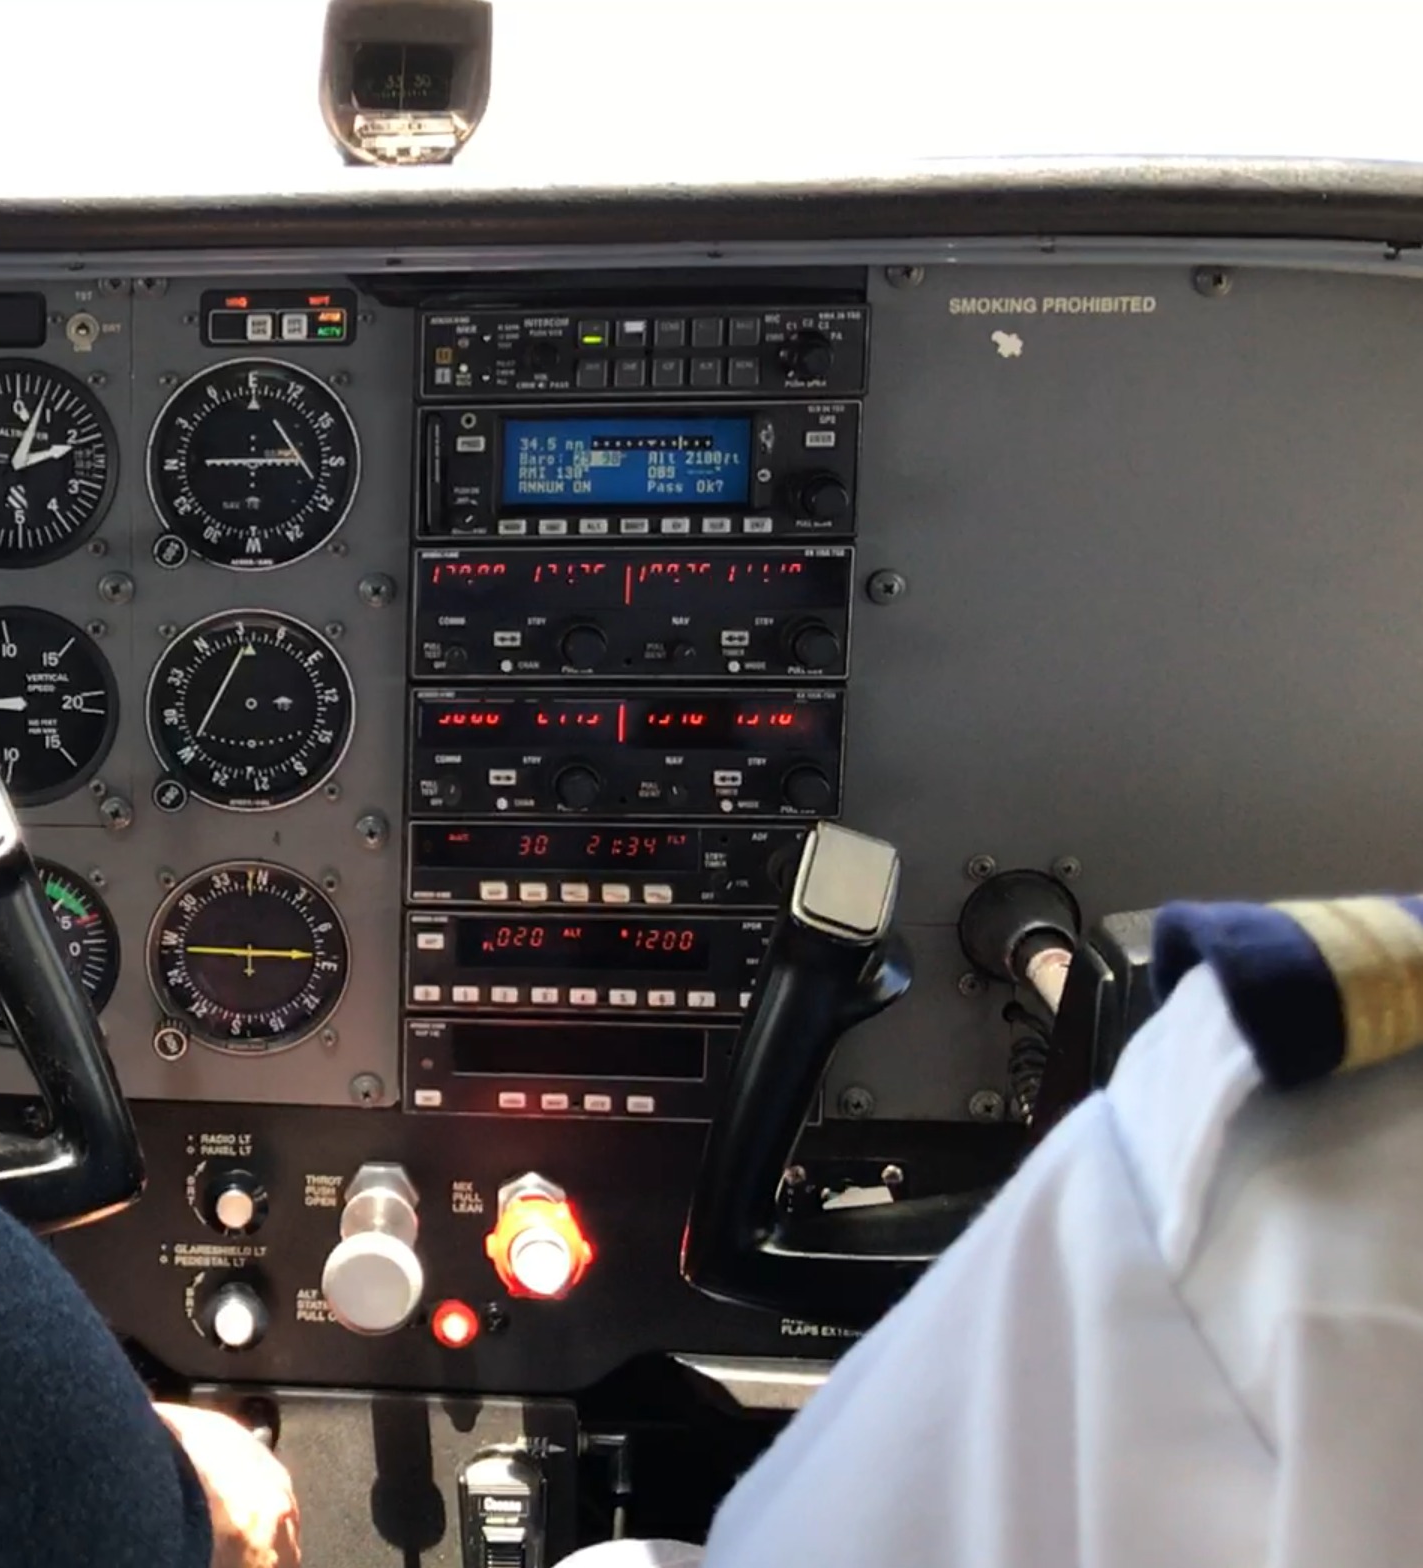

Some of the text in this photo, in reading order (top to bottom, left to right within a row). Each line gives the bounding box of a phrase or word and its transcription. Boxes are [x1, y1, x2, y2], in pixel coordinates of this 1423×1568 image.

[949, 296, 1156, 314] SMOKING PROHIBITED
[524, 318, 569, 327] INTERCOM
[786, 322, 798, 331] C1
[803, 319, 814, 327] C2
[317, 327, 342, 336] ACTV
[248, 371, 259, 387] E
[206, 385, 218, 399] 6
[287, 381, 305, 398] 12
[13, 400, 25, 414] 0
[45, 408, 51, 423] 1
[319, 412, 335, 429] 15
[176, 417, 190, 429] 3
[67, 429, 77, 445] 2
[520, 437, 557, 451] 34.5
[163, 459, 179, 471] N
[328, 456, 346, 468] S
[519, 452, 564, 466] Baro:
[648, 451, 676, 465] Alt
[519, 467, 546, 480] RMI
[68, 479, 79, 494] 3
[573, 481, 592, 493] ON
[647, 480, 724, 493] Pass Ok?
[47, 497, 59, 510] 4
[173, 496, 191, 515] 33
[318, 495, 335, 512] 21
[15, 510, 25, 524] 5
[203, 526, 222, 543] 30
[285, 524, 304, 542] 24
[245, 538, 262, 553] W
[527, 617, 547, 625] STBY
[671, 617, 690, 625] NAV
[235, 621, 245, 636] 3
[276, 626, 287, 640] 6
[2, 643, 17, 658] 10
[193, 636, 210, 653] N
[42, 652, 59, 666] 15
[306, 649, 324, 666] E
[517, 661, 540, 669] CHAN
[26, 673, 69, 682] VERTICAL
[167, 668, 184, 686] 33
[27, 684, 56, 692] SPEED
[62, 695, 84, 709] 20
[324, 688, 339, 703] 12
[163, 709, 178, 725] 30
[45, 735, 60, 749] 15
[318, 729, 333, 744] 15
[4, 747, 20, 762] 10
[177, 747, 196, 765] W
[435, 755, 462, 764] COMM
[665, 756, 684, 765] NAV
[748, 757, 767, 766] STBY
[292, 761, 308, 777] S
[211, 771, 229, 787] 24
[254, 777, 270, 791] 21
[752, 833, 768, 841] ADF
[212, 873, 231, 888] 33
[256, 869, 269, 885] N
[295, 887, 307, 901] 3
[179, 893, 197, 912] 30
[319, 922, 332, 933] 6
[563, 928, 582, 938] ALT
[161, 930, 178, 946] W
[497, 927, 544, 947] 020
[635, 930, 694, 950] 1200
[321, 961, 338, 972] E
[167, 970, 183, 986] 24
[188, 1002, 208, 1018] 21
[303, 995, 320, 1013] 12
[230, 1019, 241, 1035] S
[268, 1017, 286, 1032] 15
[200, 1133, 252, 1145] RADIO LT
[200, 1145, 253, 1156] PANEL LT
[305, 1175, 343, 1186] THROT
[453, 1181, 473, 1192] MIX
[305, 1186, 336, 1196] PUSH
[453, 1192, 482, 1202] PULL
[305, 1196, 337, 1207] OPEN
[453, 1202, 483, 1213] LEAN
[174, 1244, 267, 1257] GLARESHIELD LT
[174, 1256, 246, 1268] PEDESTAL LT
[297, 1288, 318, 1300] ALT
[297, 1310, 326, 1321] PULL
[781, 1325, 819, 1336] FLAPS
